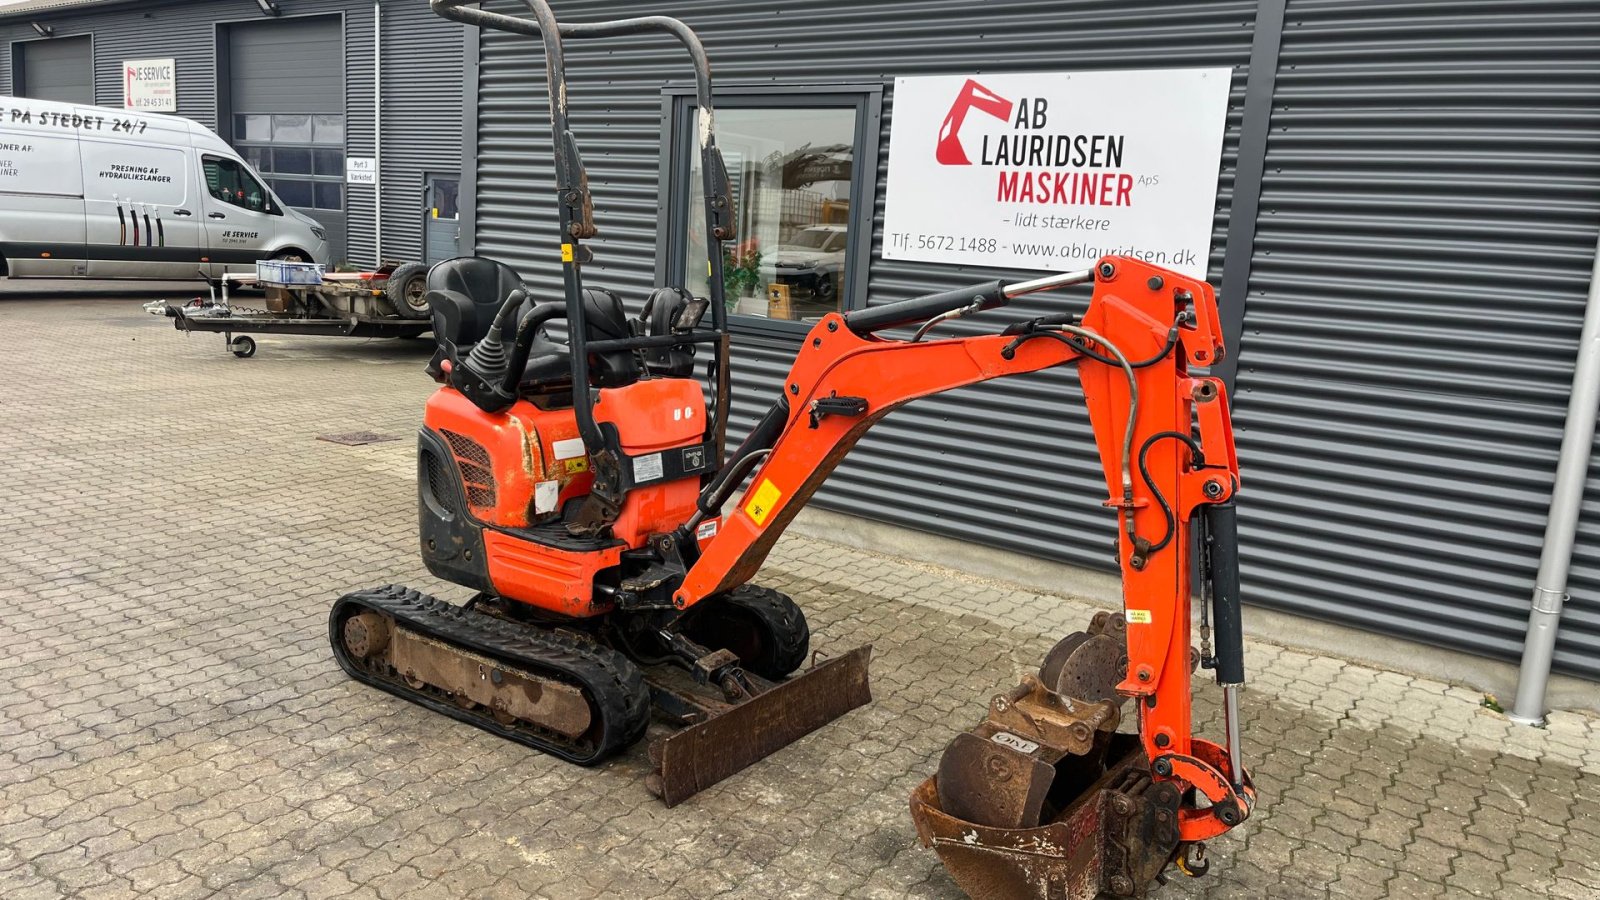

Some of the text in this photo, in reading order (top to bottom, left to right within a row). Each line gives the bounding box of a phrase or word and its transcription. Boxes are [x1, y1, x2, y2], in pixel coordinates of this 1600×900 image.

[143, 66, 171, 81] SERVICE
[1014, 97, 1048, 129] AB
[39, 112, 105, 130] STEDET
[111, 118, 148, 135] 24/7
[981, 135, 1124, 168] LAURIDSEN
[99, 171, 171, 183] HYDRAULIKSLANGER
[111, 164, 148, 174] PRESNING
[997, 171, 1159, 207] MASKINER ApS
[1014, 212, 1038, 228] lidt
[1042, 214, 1110, 231] stærkere
[232, 231, 259, 239] SERVICE
[892, 233, 913, 251] Tlf.
[918, 235, 954, 251] 5672
[959, 237, 997, 254] 1488
